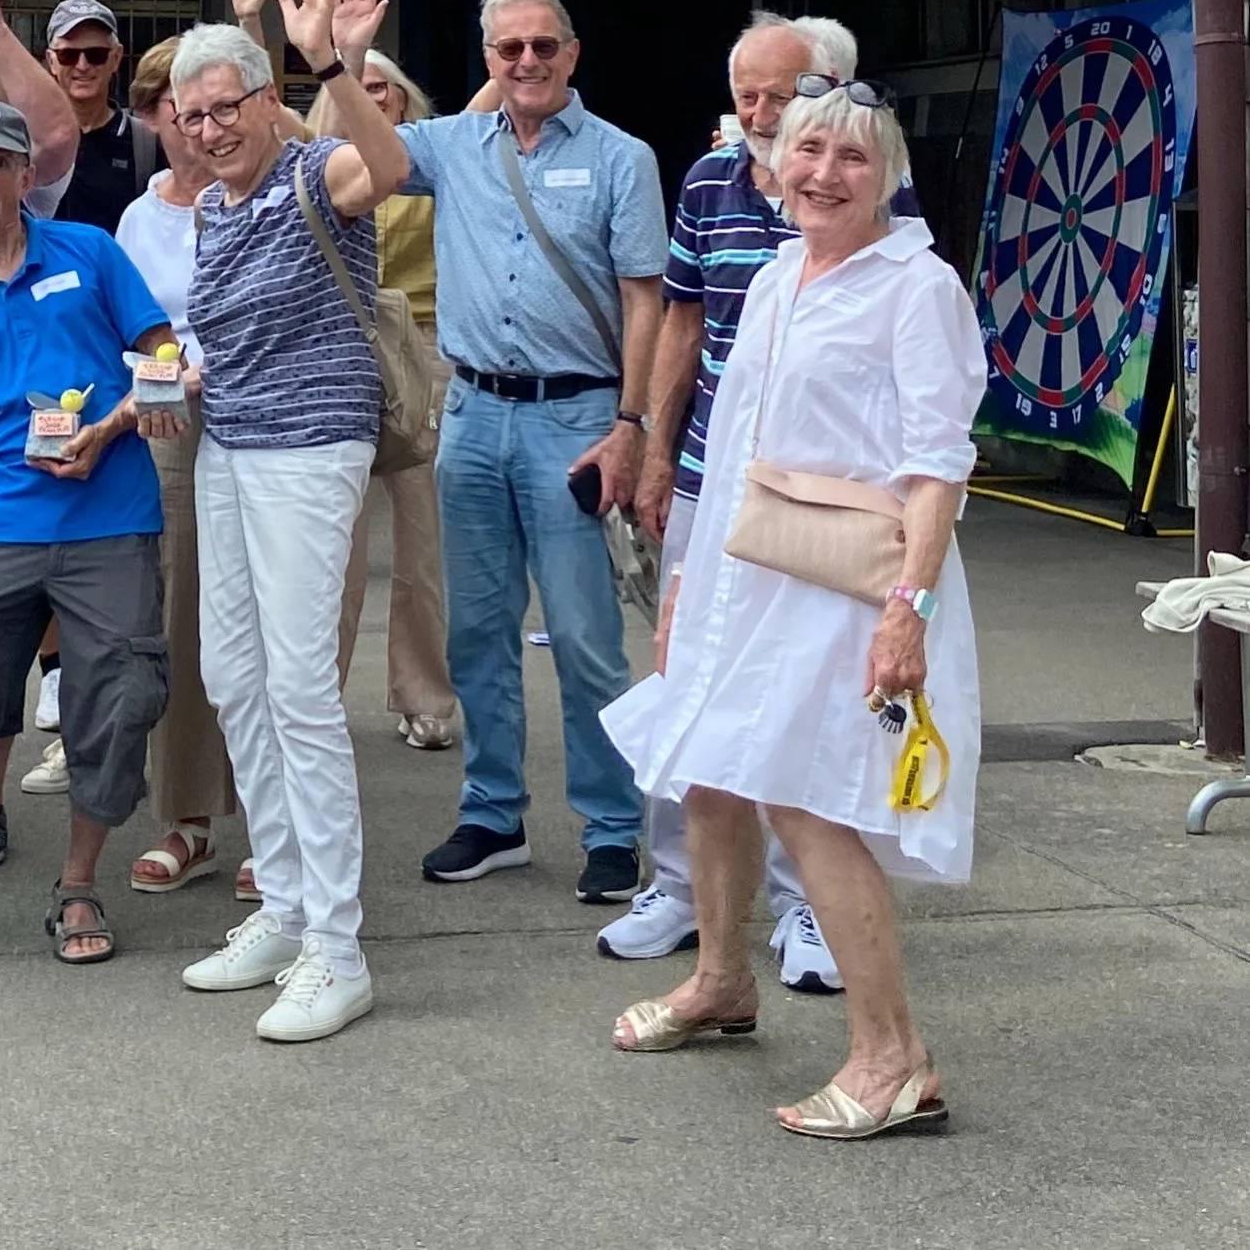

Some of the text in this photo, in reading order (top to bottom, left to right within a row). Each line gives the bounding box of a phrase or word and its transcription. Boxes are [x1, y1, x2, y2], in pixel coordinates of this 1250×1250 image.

[1090, 21, 1111, 36] 20
[1125, 24, 1133, 40] 1
[1064, 33, 1074, 49] 5
[1147, 38, 1163, 67] 18
[1034, 53, 1048, 76] 12
[1094, 382, 1104, 404] 2
[1015, 392, 1033, 417] 19
[1071, 404, 1083, 425] 17
[1049, 410, 1058, 429] 3
